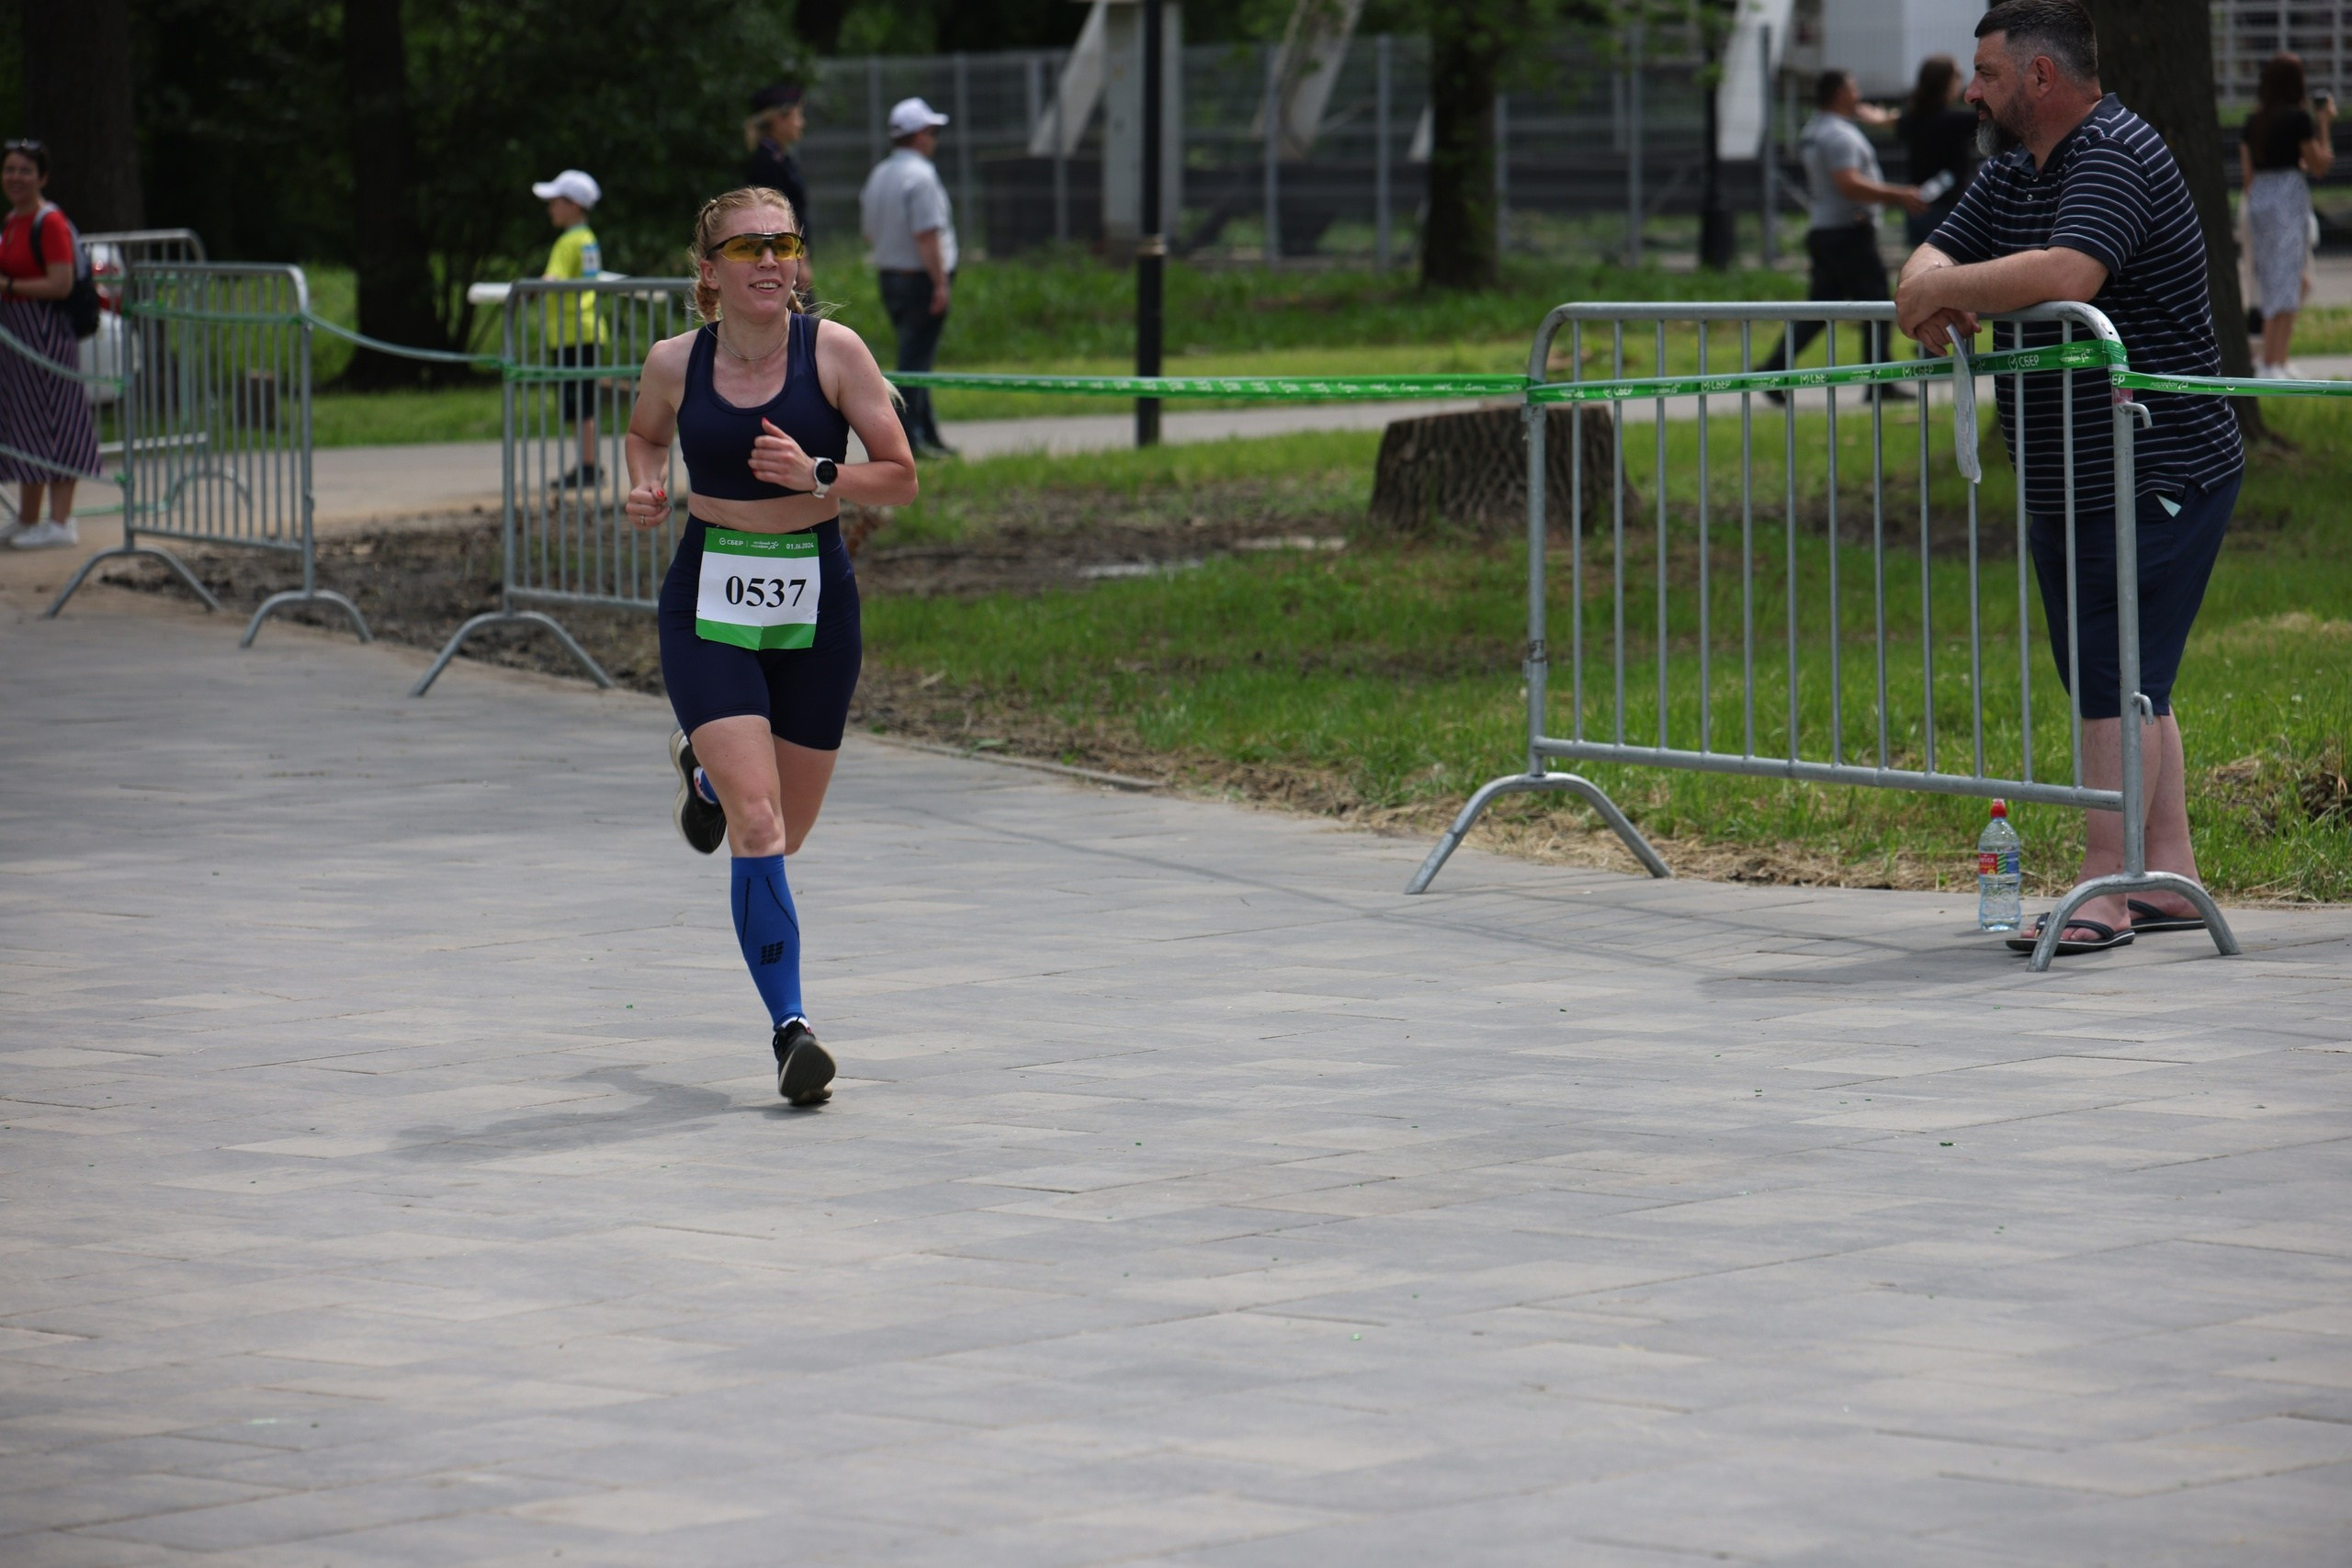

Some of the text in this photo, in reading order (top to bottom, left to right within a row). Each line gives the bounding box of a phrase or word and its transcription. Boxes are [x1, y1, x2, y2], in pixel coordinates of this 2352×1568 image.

[2018, 355, 2040, 367] СБЕР
[1913, 365, 1934, 377] СБЕР
[2110, 374, 2126, 386] ЕР
[725, 575, 807, 608] 0537
